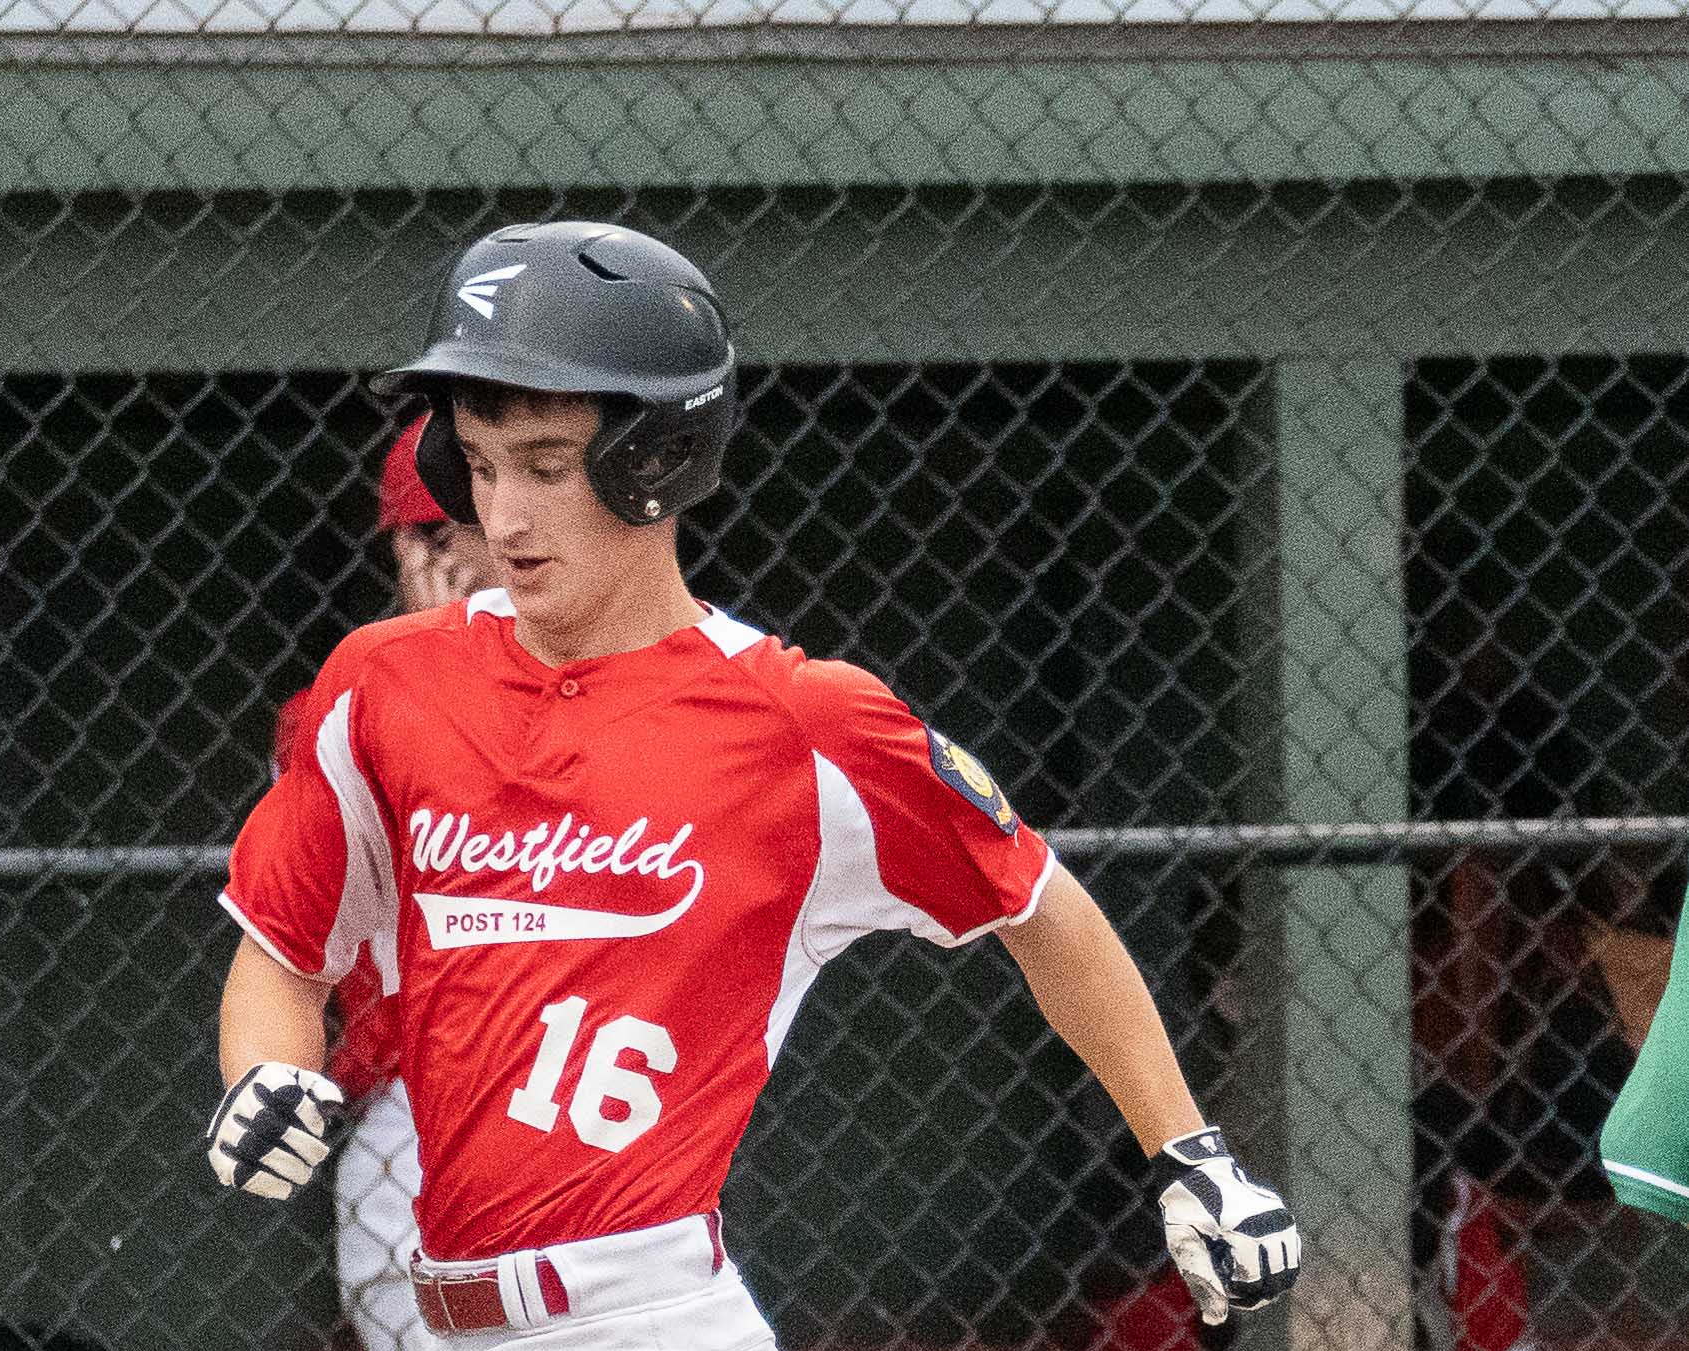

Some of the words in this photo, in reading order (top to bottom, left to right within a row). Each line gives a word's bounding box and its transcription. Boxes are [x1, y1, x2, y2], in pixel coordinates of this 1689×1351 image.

[685, 385, 724, 411] EASTON
[410, 808, 704, 893] Westfield
[446, 912, 503, 933] POST
[512, 911, 547, 932] 124
[507, 995, 678, 1153] 16
